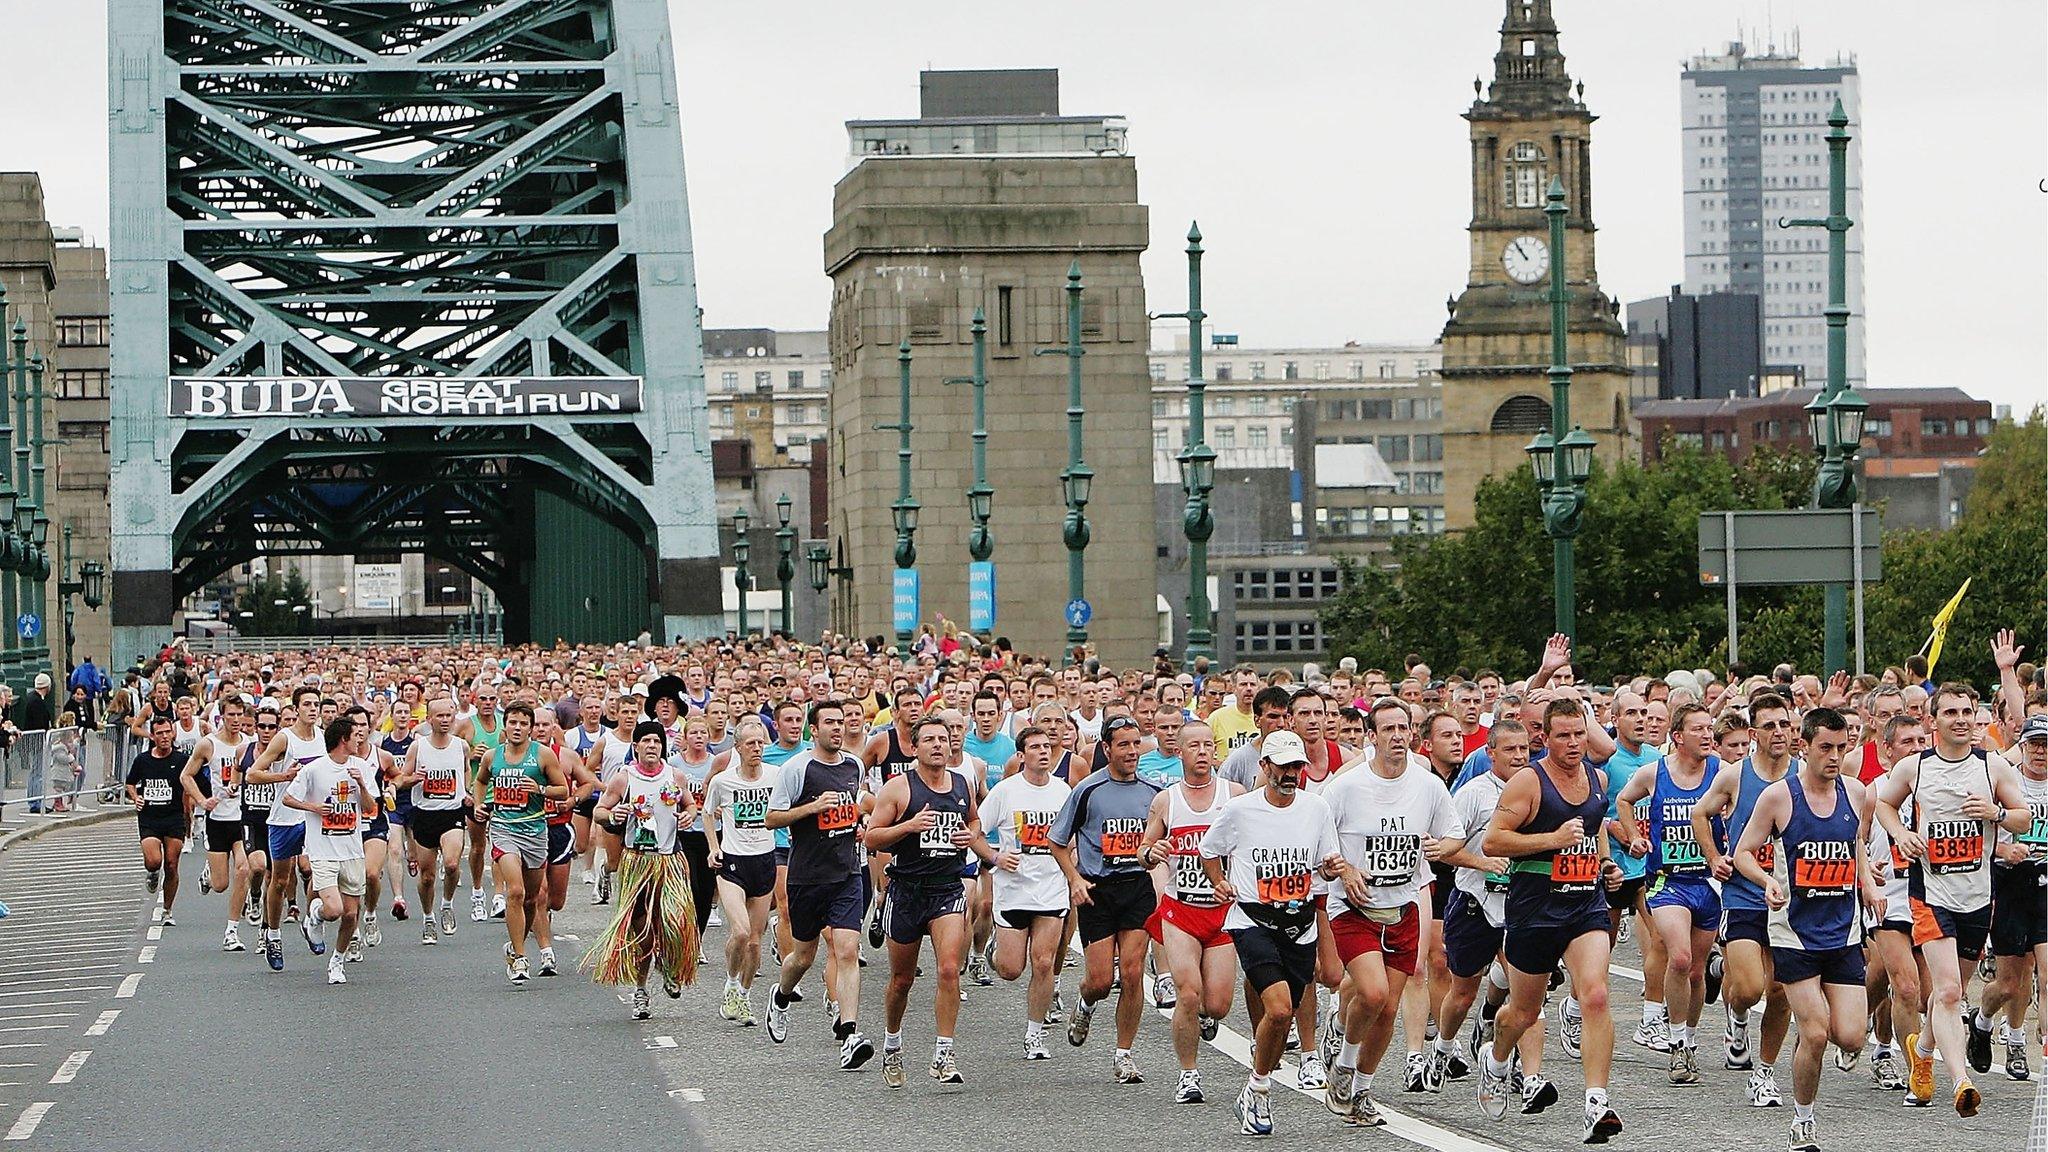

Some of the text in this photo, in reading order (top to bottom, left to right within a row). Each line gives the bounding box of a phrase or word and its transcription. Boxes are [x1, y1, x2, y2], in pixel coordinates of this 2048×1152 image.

[184, 379, 354, 416] BUPA
[381, 379, 521, 399] GREAT
[381, 392, 620, 414] NORTH RUN
[427, 769, 453, 780] BUPA
[499, 768, 525, 777] ANDY
[145, 778, 170, 789] BUPA
[495, 788, 524, 801] 8305
[822, 805, 854, 825] 5348
[1026, 811, 1059, 826] BUP
[1381, 816, 1405, 832] PAT
[1105, 818, 1144, 834] BUPA
[1932, 821, 1979, 840] BUPA
[1177, 833, 1206, 851] BOA
[1371, 835, 1414, 852] BUPA
[1668, 842, 1705, 860] 270
[1802, 841, 1851, 860] BUPA
[1934, 839, 1977, 858] 5831
[1252, 847, 1309, 862] GRAHAM
[1368, 851, 1418, 871] 16346
[1261, 862, 1308, 879] BUPA
[1560, 855, 1597, 876] 8172
[1804, 860, 1850, 882] 7777
[1262, 877, 1306, 898] 7199
